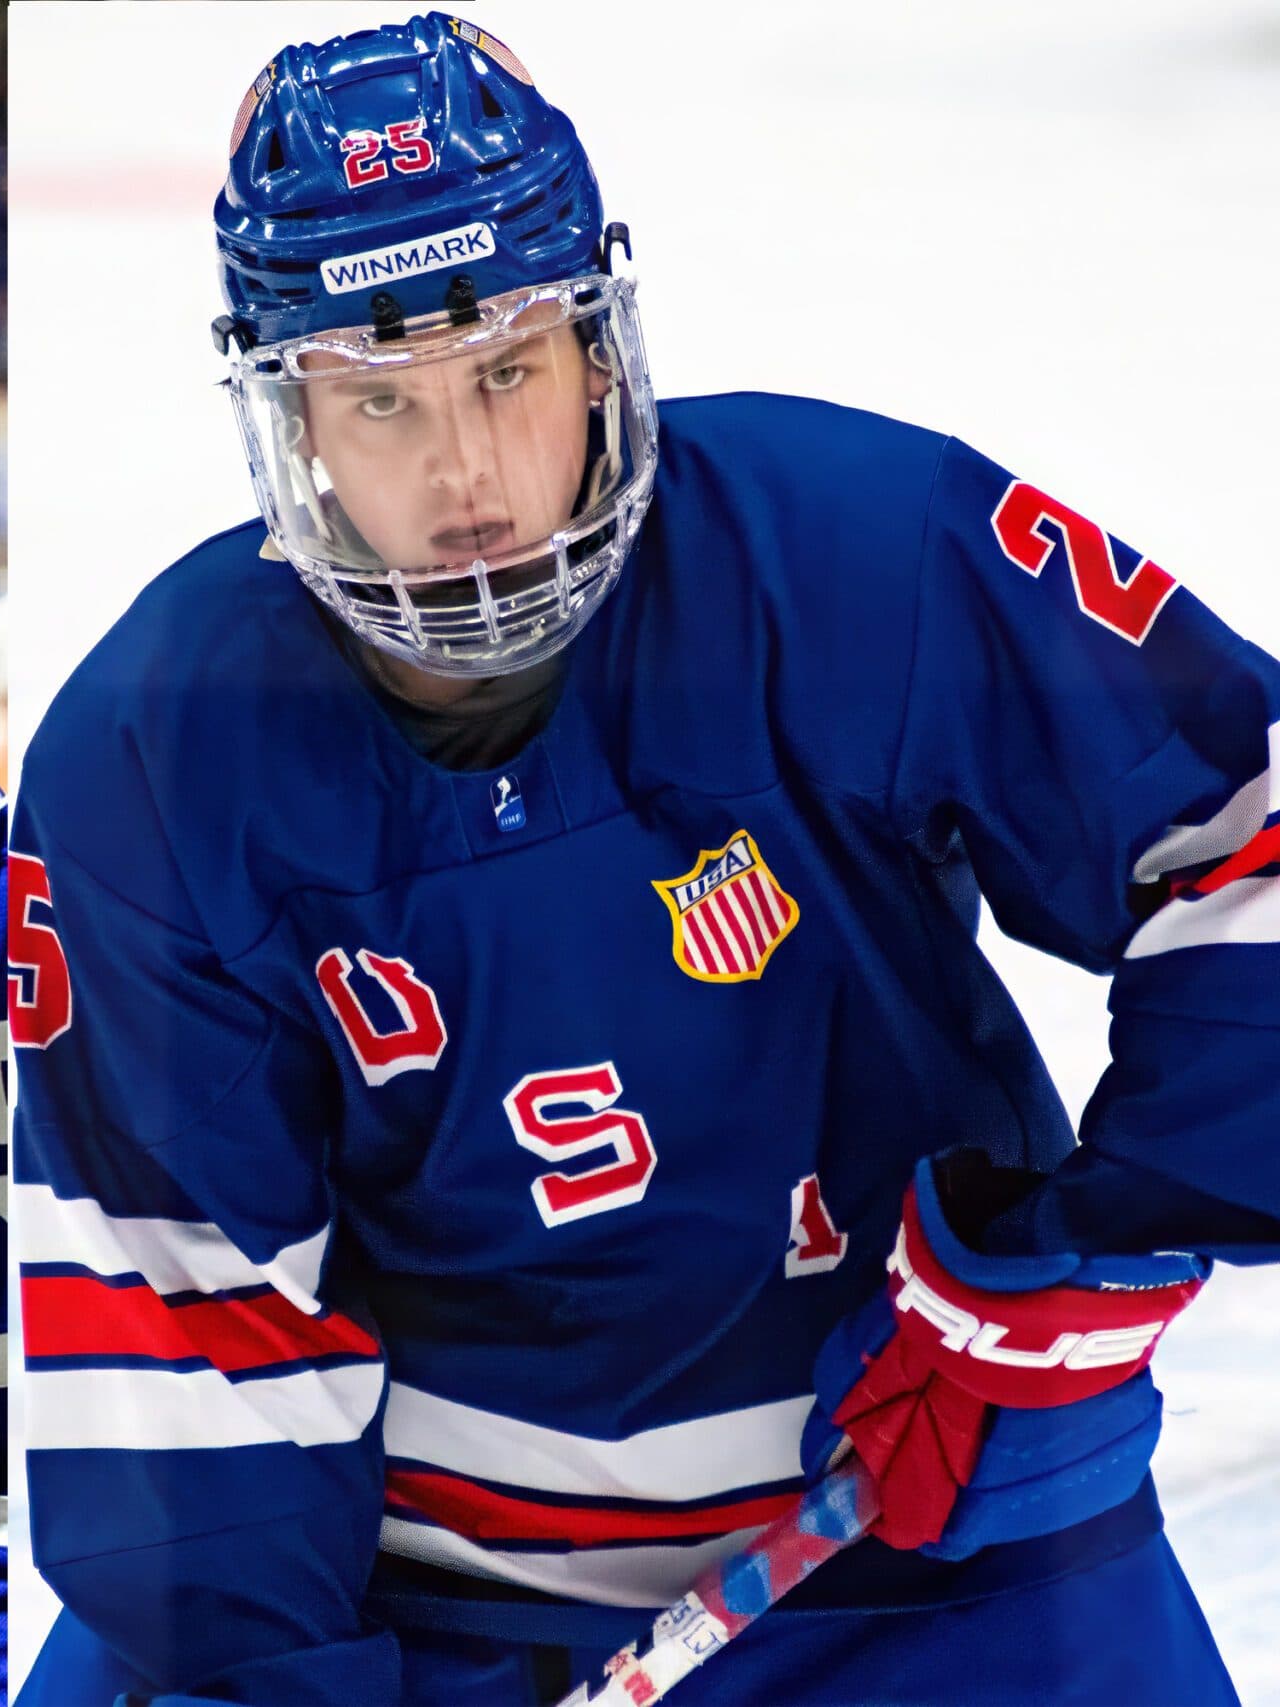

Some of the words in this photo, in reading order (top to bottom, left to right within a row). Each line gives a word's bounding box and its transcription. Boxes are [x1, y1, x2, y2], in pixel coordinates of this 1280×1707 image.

[340, 117, 434, 189] 25
[327, 229, 489, 288] WINMARK
[991, 479, 1176, 647] 2
[686, 850, 746, 903] USA
[886, 1221, 1166, 1370] TRUE
